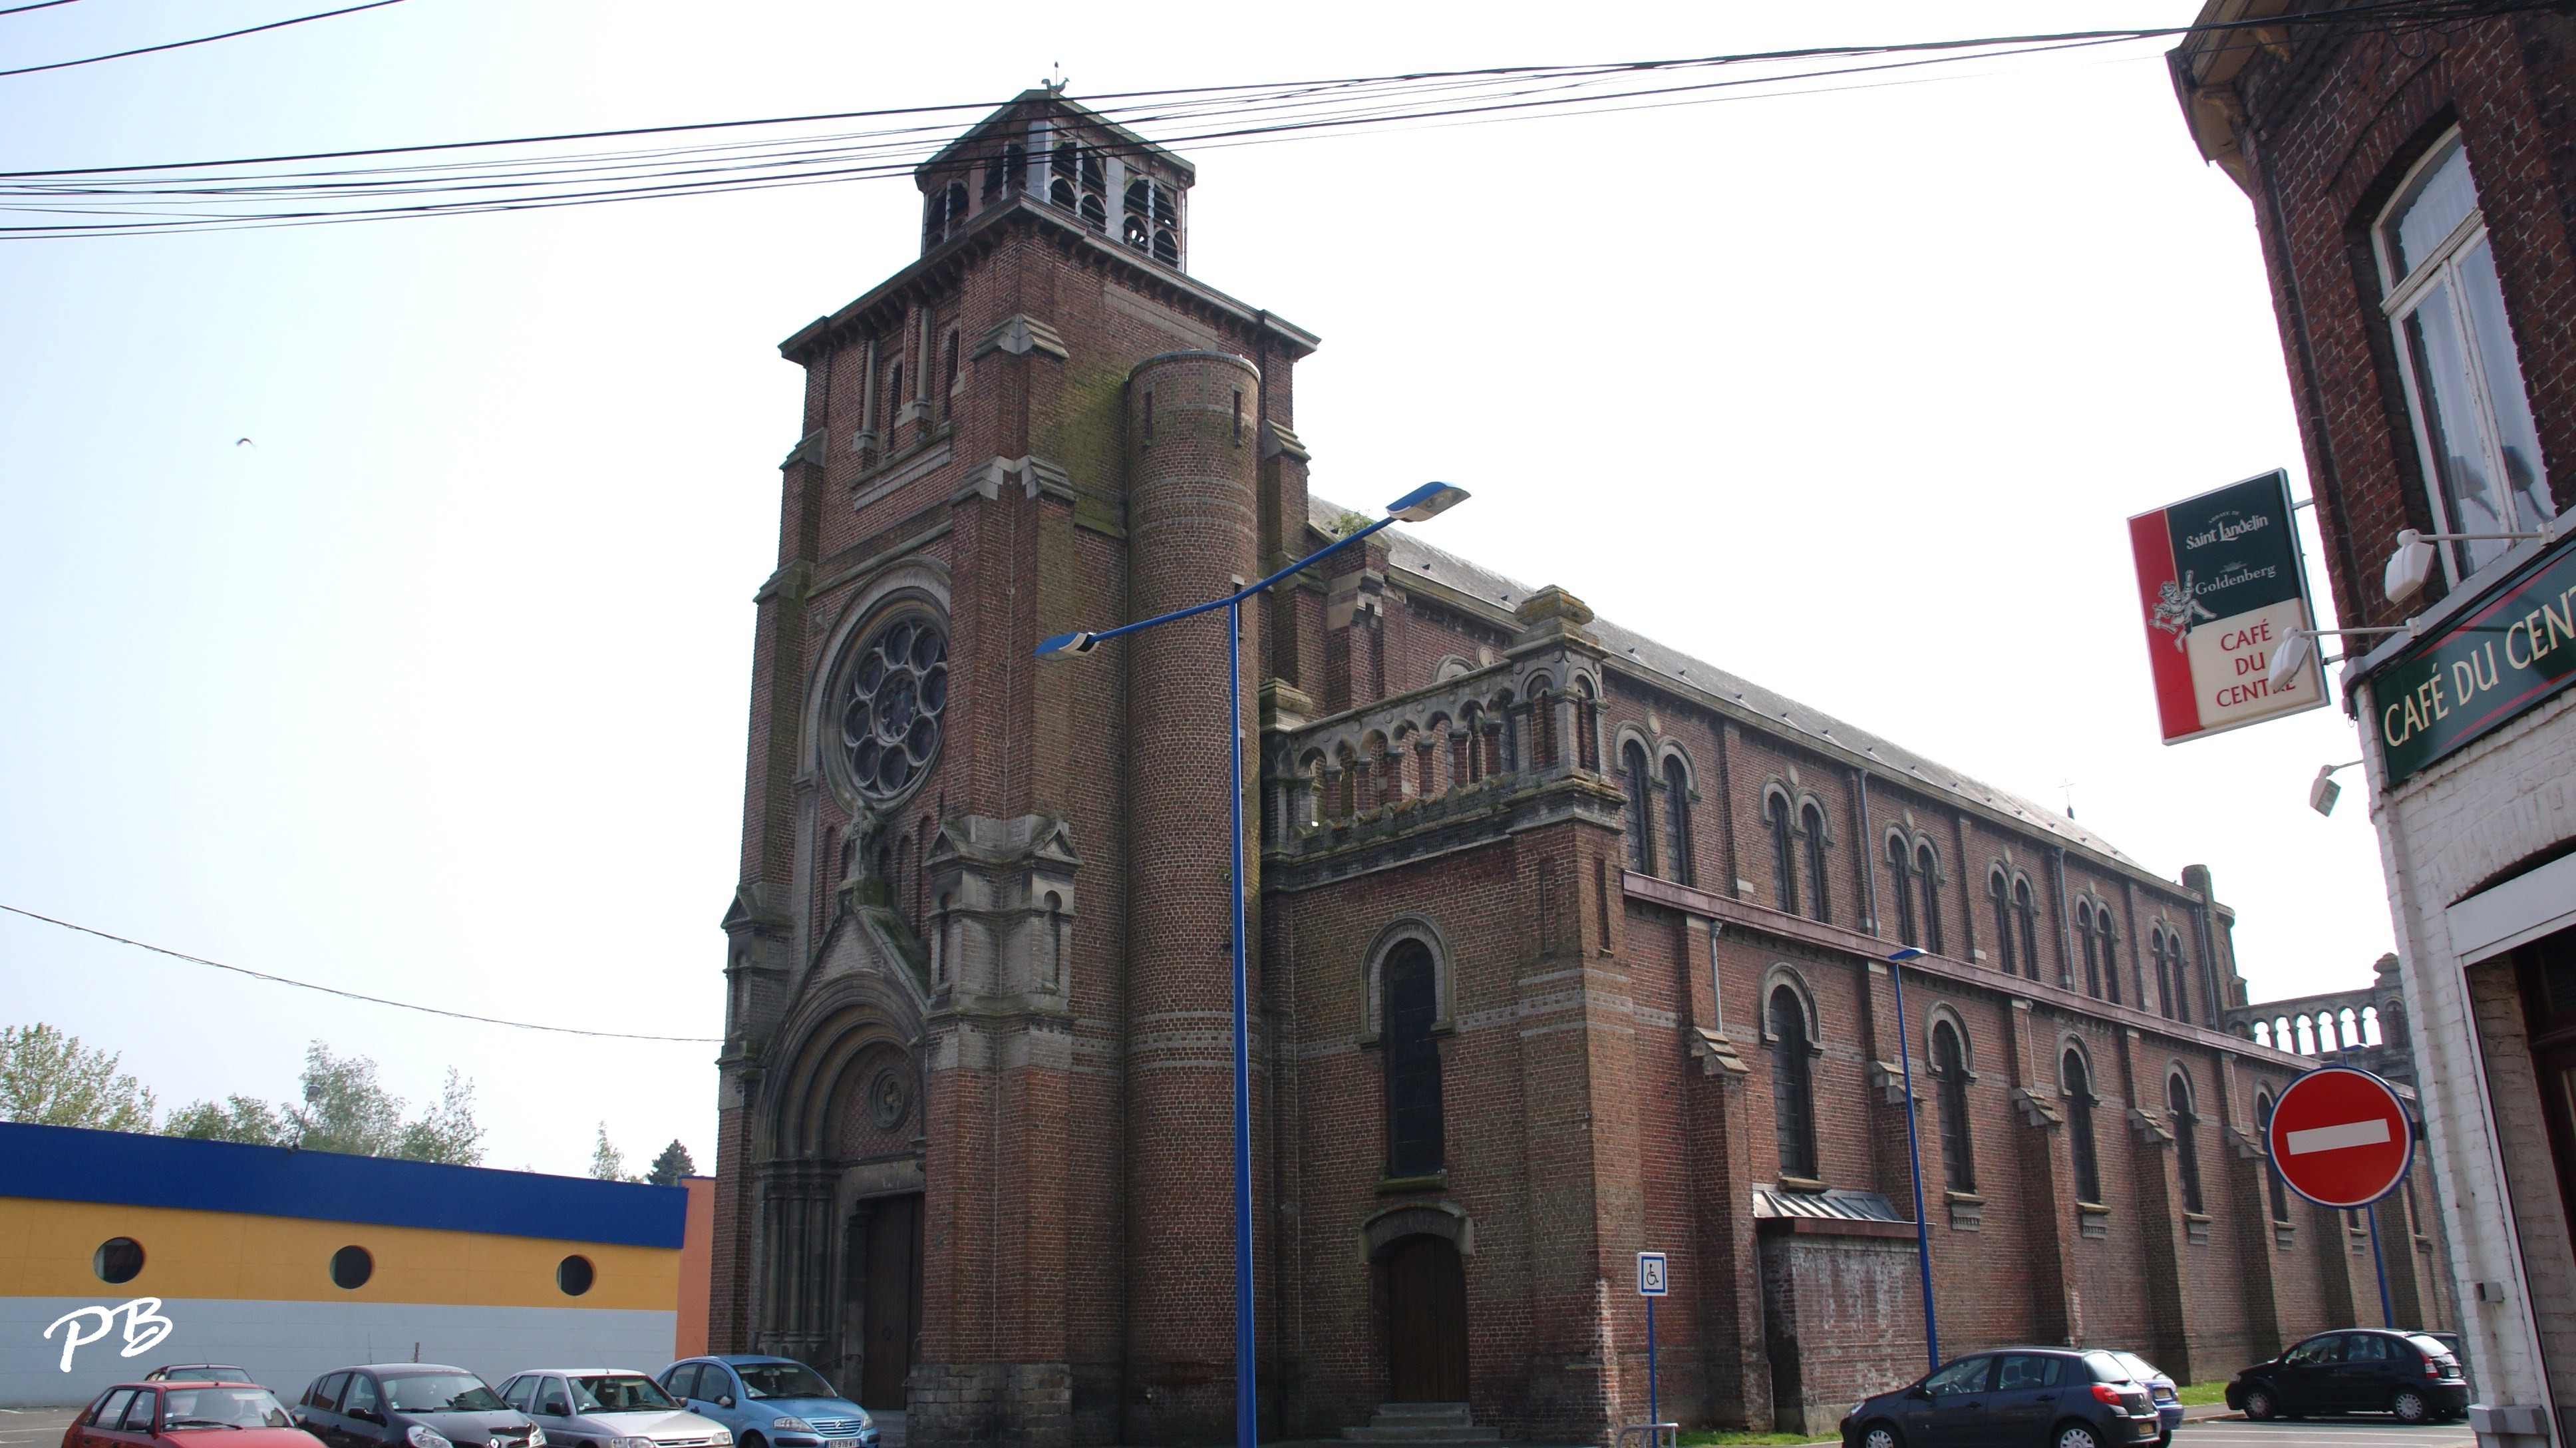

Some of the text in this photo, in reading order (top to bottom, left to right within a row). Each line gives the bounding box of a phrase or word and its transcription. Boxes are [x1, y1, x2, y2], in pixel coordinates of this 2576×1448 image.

[2186, 515, 2269, 550] Saint Landelin
[2195, 565, 2276, 595] Goldenberg
[2220, 618, 2273, 651] CAFÉ
[2235, 651, 2266, 676] DU
[2216, 678, 2297, 707] CENTE
[2384, 663, 2449, 747] CAFÉ
[2452, 641, 2499, 706] DU
